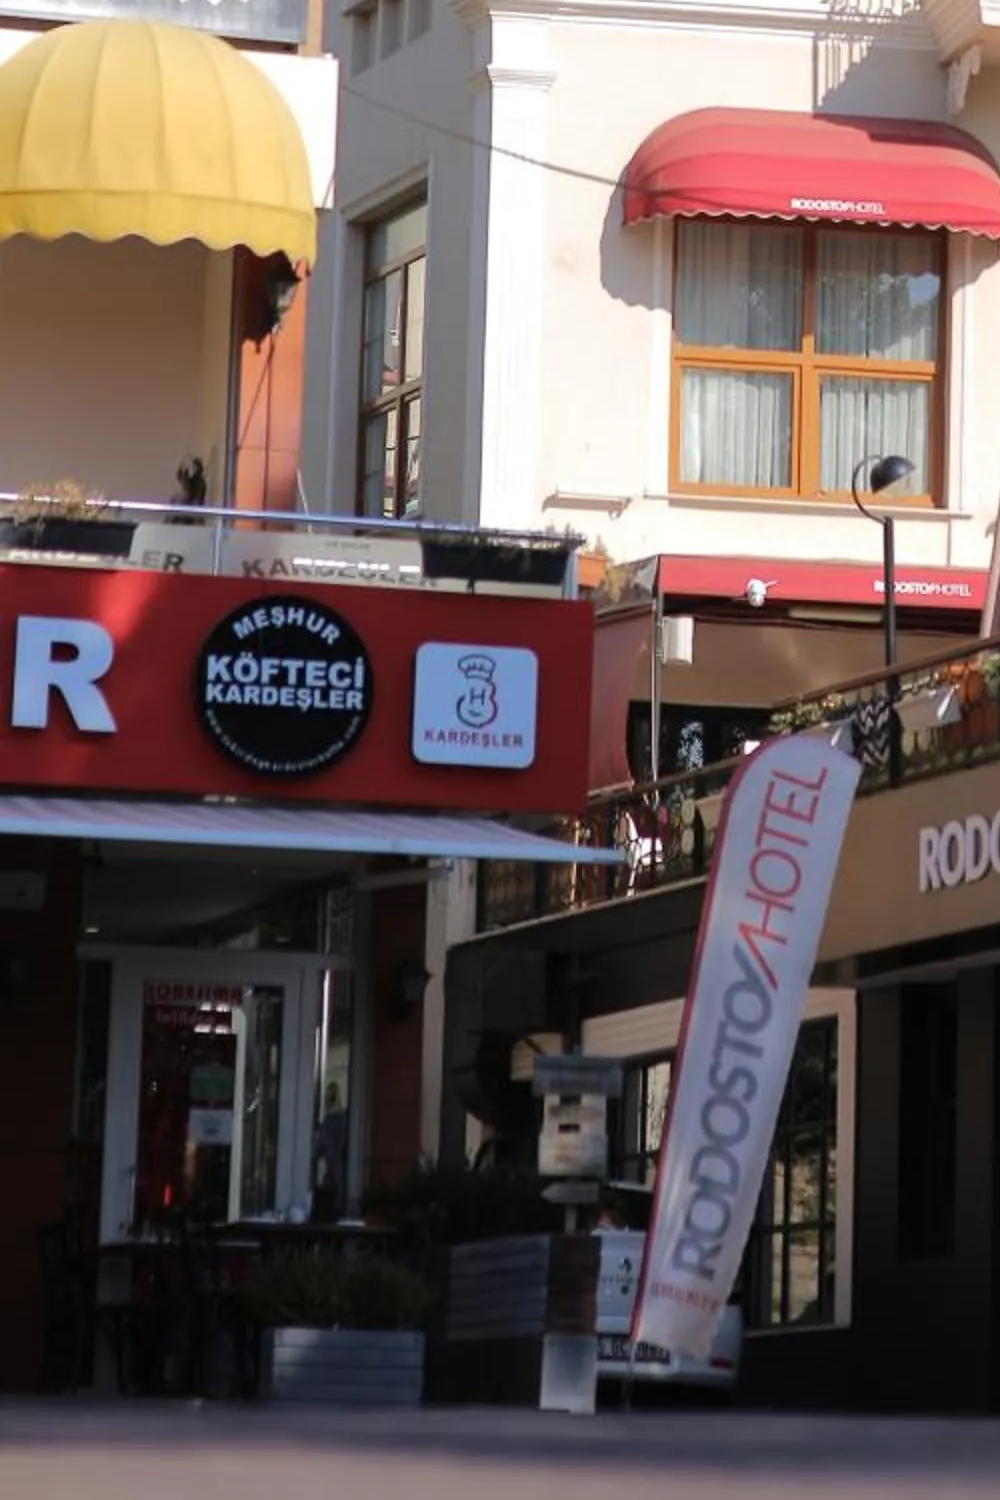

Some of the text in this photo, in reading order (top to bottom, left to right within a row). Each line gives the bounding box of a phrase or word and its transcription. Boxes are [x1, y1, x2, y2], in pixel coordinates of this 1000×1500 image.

[232, 605, 341, 646] MEŞHUR
[11, 614, 118, 734] R
[206, 651, 365, 689] KÖFTECİ
[205, 683, 364, 713] KARDEŞLER
